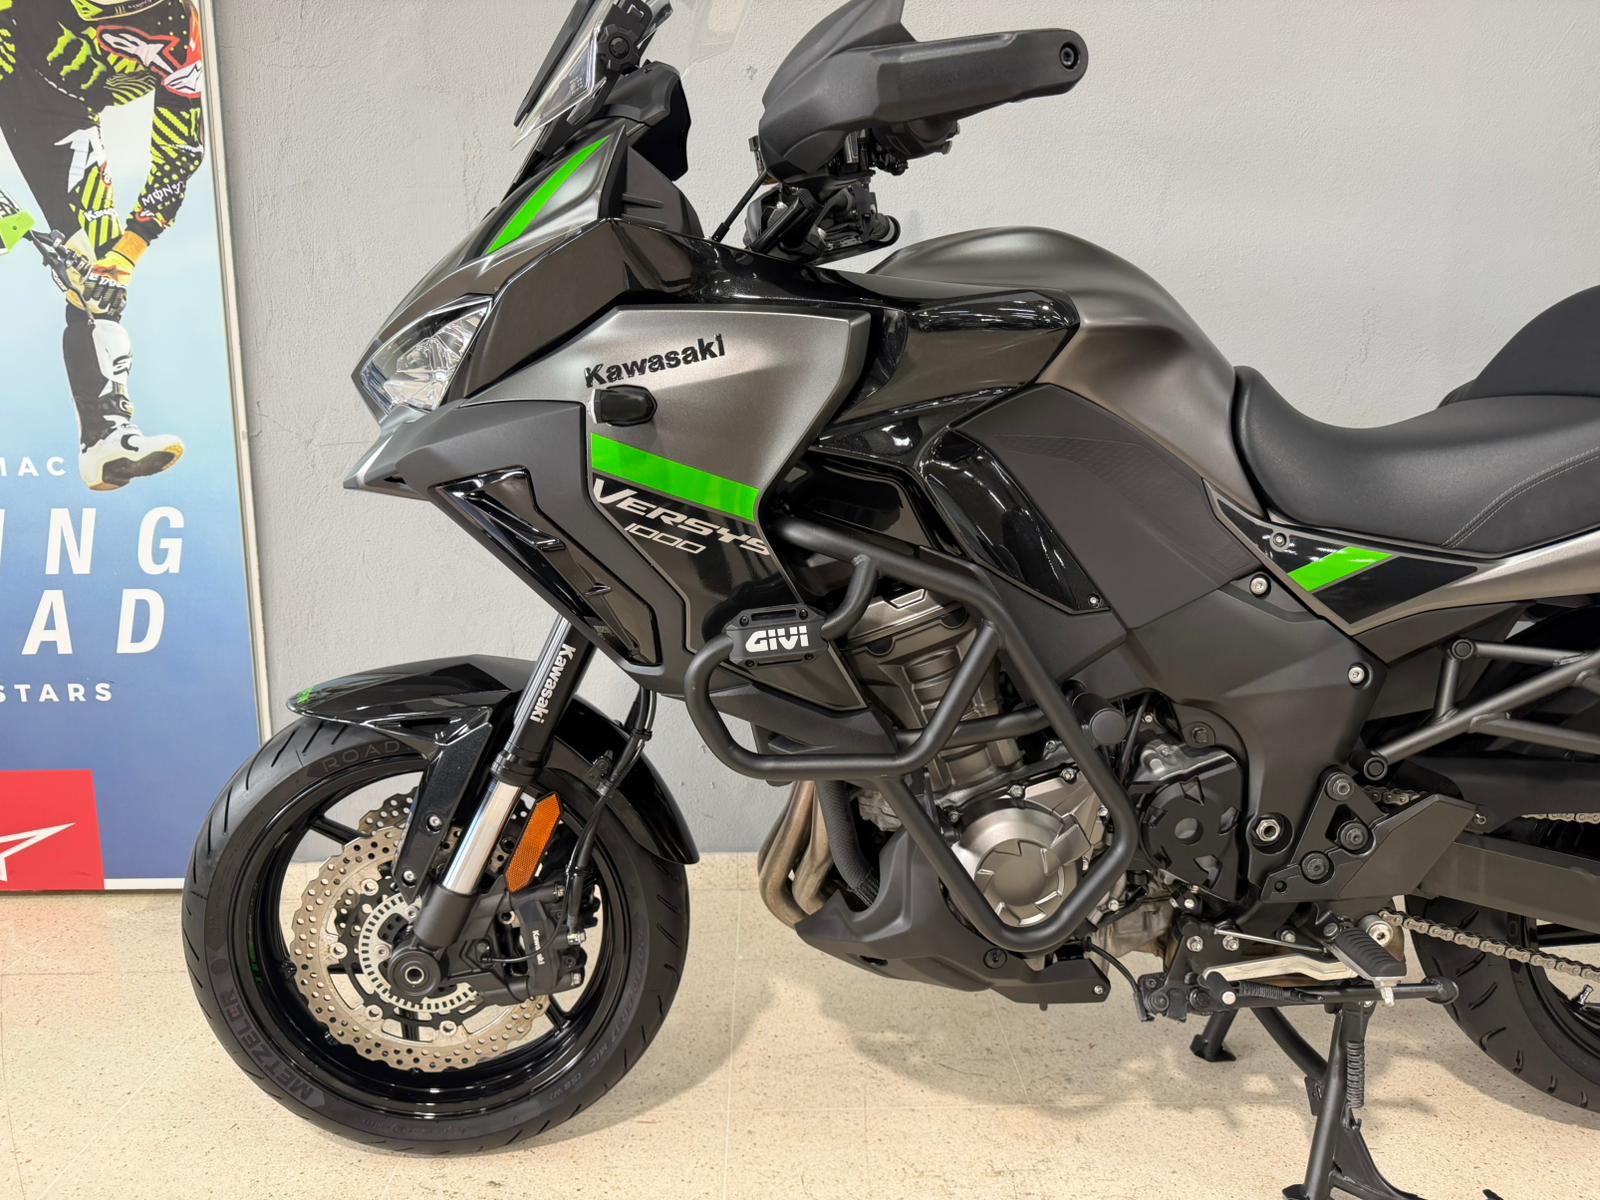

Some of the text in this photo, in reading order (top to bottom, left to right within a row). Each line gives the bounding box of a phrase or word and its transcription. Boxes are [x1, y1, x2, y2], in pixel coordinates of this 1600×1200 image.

[584, 333, 726, 388] Kawasaki
[624, 522, 707, 555] 1000
[745, 625, 809, 653] GIVI
[530, 643, 577, 724] Kawasaki
[220, 989, 315, 1101] METZELER
